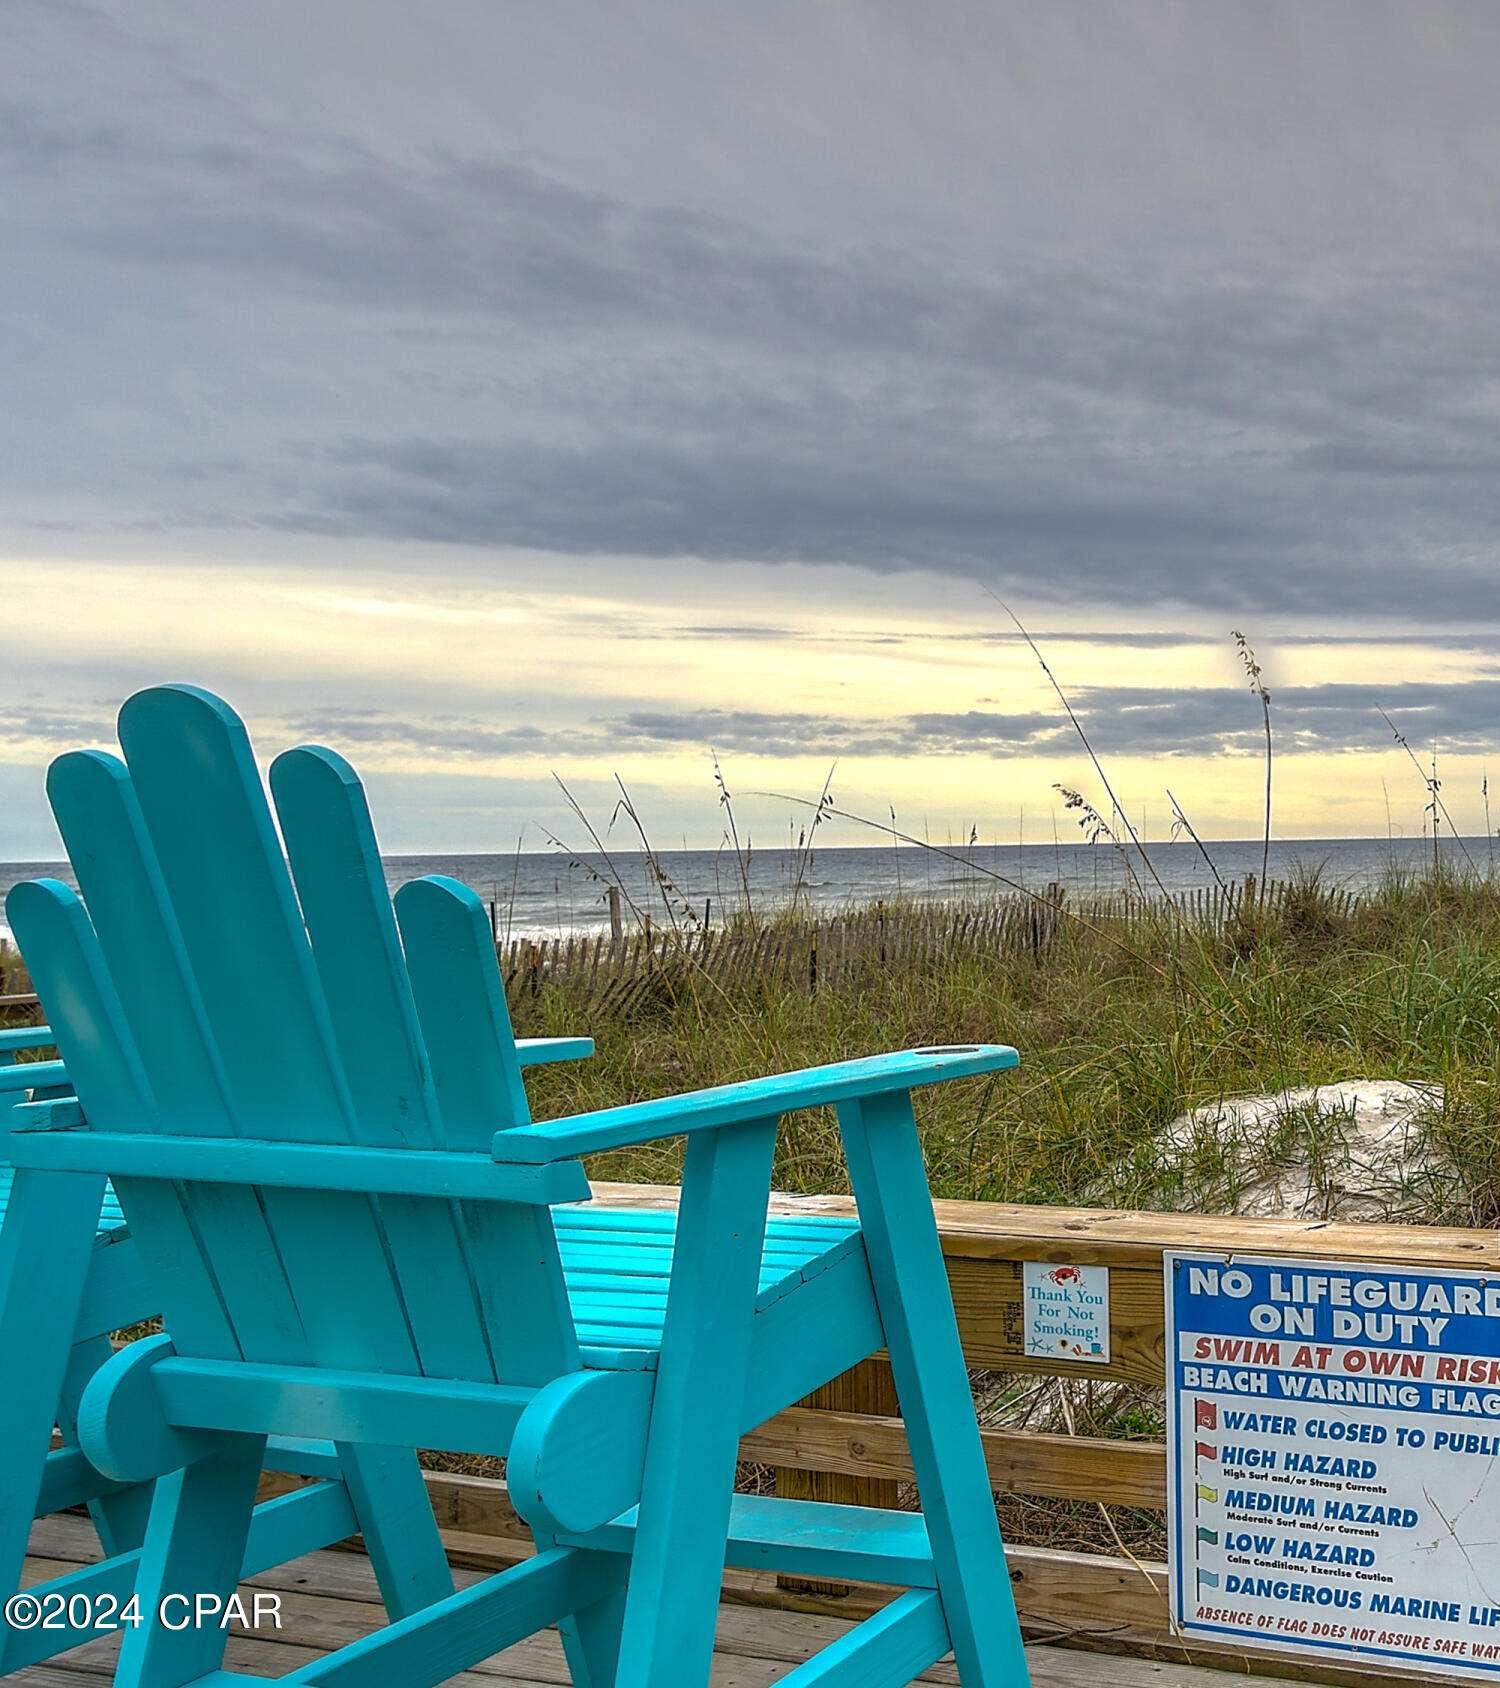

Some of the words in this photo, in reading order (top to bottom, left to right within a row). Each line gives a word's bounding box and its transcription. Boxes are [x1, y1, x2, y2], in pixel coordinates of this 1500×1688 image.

[1028, 1287, 1072, 1302] Thank
[1077, 1291, 1103, 1304] You
[1189, 1267, 1252, 1298] NO
[1038, 1304, 1061, 1317] For
[1068, 1306, 1094, 1320] Not
[1249, 1304, 1314, 1336] ON
[1333, 1312, 1449, 1346] DUTY
[1033, 1321, 1098, 1341] Smoking!
[1194, 1338, 1280, 1366] SWIM
[1292, 1345, 1332, 1369] AT
[1343, 1351, 1425, 1378] OWN
[1184, 1367, 1268, 1394] BEACH
[1278, 1375, 1420, 1407] WARNING
[1224, 1411, 1297, 1436] WATER
[1305, 1419, 1387, 1444] CLOSED
[1396, 1428, 1425, 1448] TO
[1221, 1446, 1276, 1469] HIGH
[1284, 1453, 1377, 1479] HAZARD
[1224, 1469, 1245, 1480] High
[1249, 1472, 1268, 1482] Surf
[1271, 1475, 1307, 1486] and/or
[1310, 1478, 1342, 1491] Strong
[1346, 1482, 1387, 1494] Currents
[1224, 1490, 1315, 1516] MEDIUM
[1324, 1500, 1418, 1528] HAZARD
[1227, 1512, 1273, 1525] Moderate
[1277, 1518, 1296, 1528] Surf
[1300, 1521, 1335, 1533] and/or
[1338, 1525, 1379, 1537] Currents
[1225, 1532, 1275, 1554] LOW
[1283, 1540, 1375, 1567] HAZARD
[1227, 1555, 1250, 1565] Calm
[1253, 1558, 1308, 1574] Conditions,
[1311, 1565, 1351, 1579] Exercise
[1355, 1570, 1393, 1583] Caution
[1226, 1575, 1362, 1609] DANGEROUS
[1369, 1594, 1460, 1623] MARINE
[1196, 1606, 1252, 1626] ABSENCE
[1257, 1614, 1273, 1628] OF
[1277, 1617, 1307, 1634] FLAG
[1311, 1622, 1346, 1639] DOES
[1350, 1628, 1375, 1642] NOT
[1378, 1631, 1429, 1650] ASSURE
[1433, 1638, 1467, 1655] SAFE
